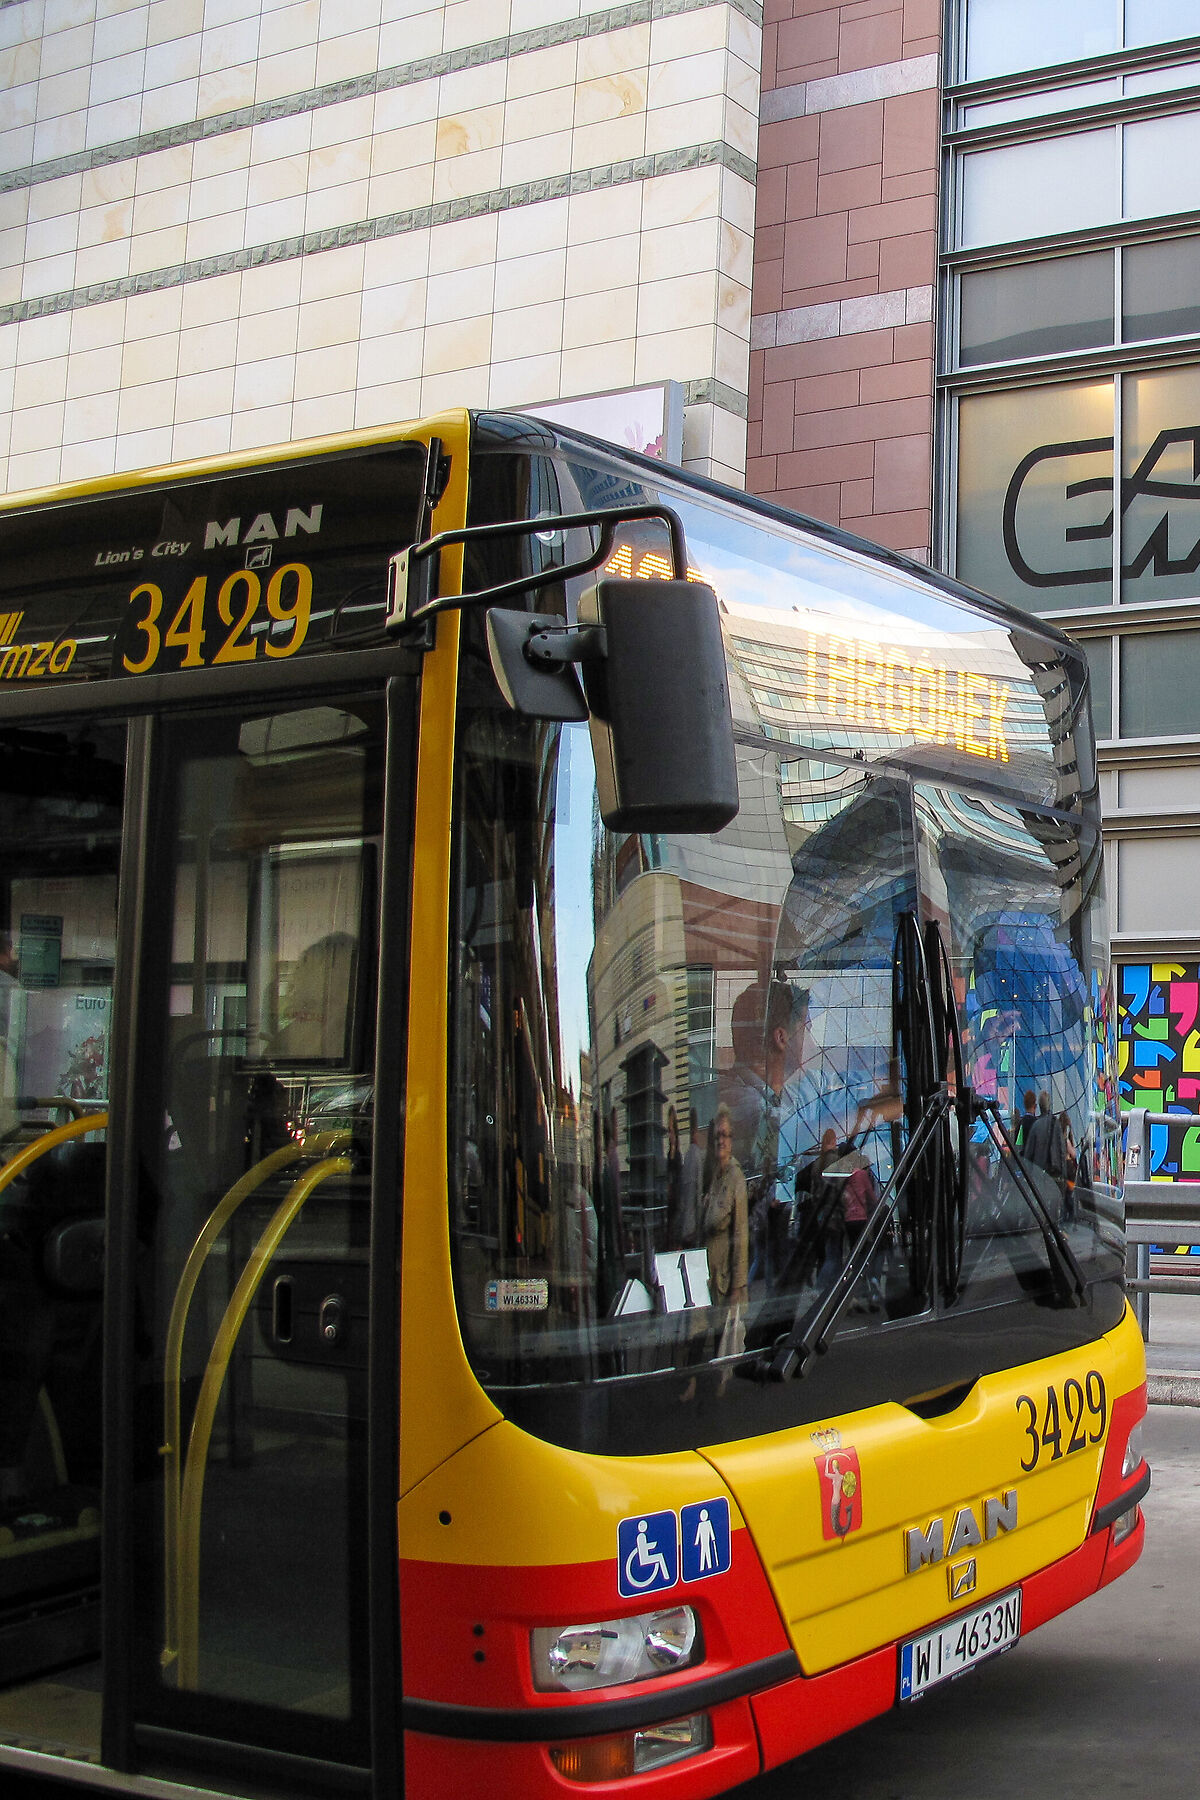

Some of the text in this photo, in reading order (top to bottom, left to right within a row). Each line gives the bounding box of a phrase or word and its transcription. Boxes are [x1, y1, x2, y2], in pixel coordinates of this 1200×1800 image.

[203, 504, 324, 550] MAN
[95, 541, 191, 567] Lion's City
[123, 563, 313, 674] 3429
[0, 638, 78, 679] mza
[515, 1295, 540, 1305] 4633N
[676, 1252, 696, 1309] 1
[1016, 1370, 1106, 1472] 3429
[904, 1487, 1018, 1574] MAN
[917, 1597, 1018, 1686] WI 4633N
[902, 1676, 911, 1690] PL
